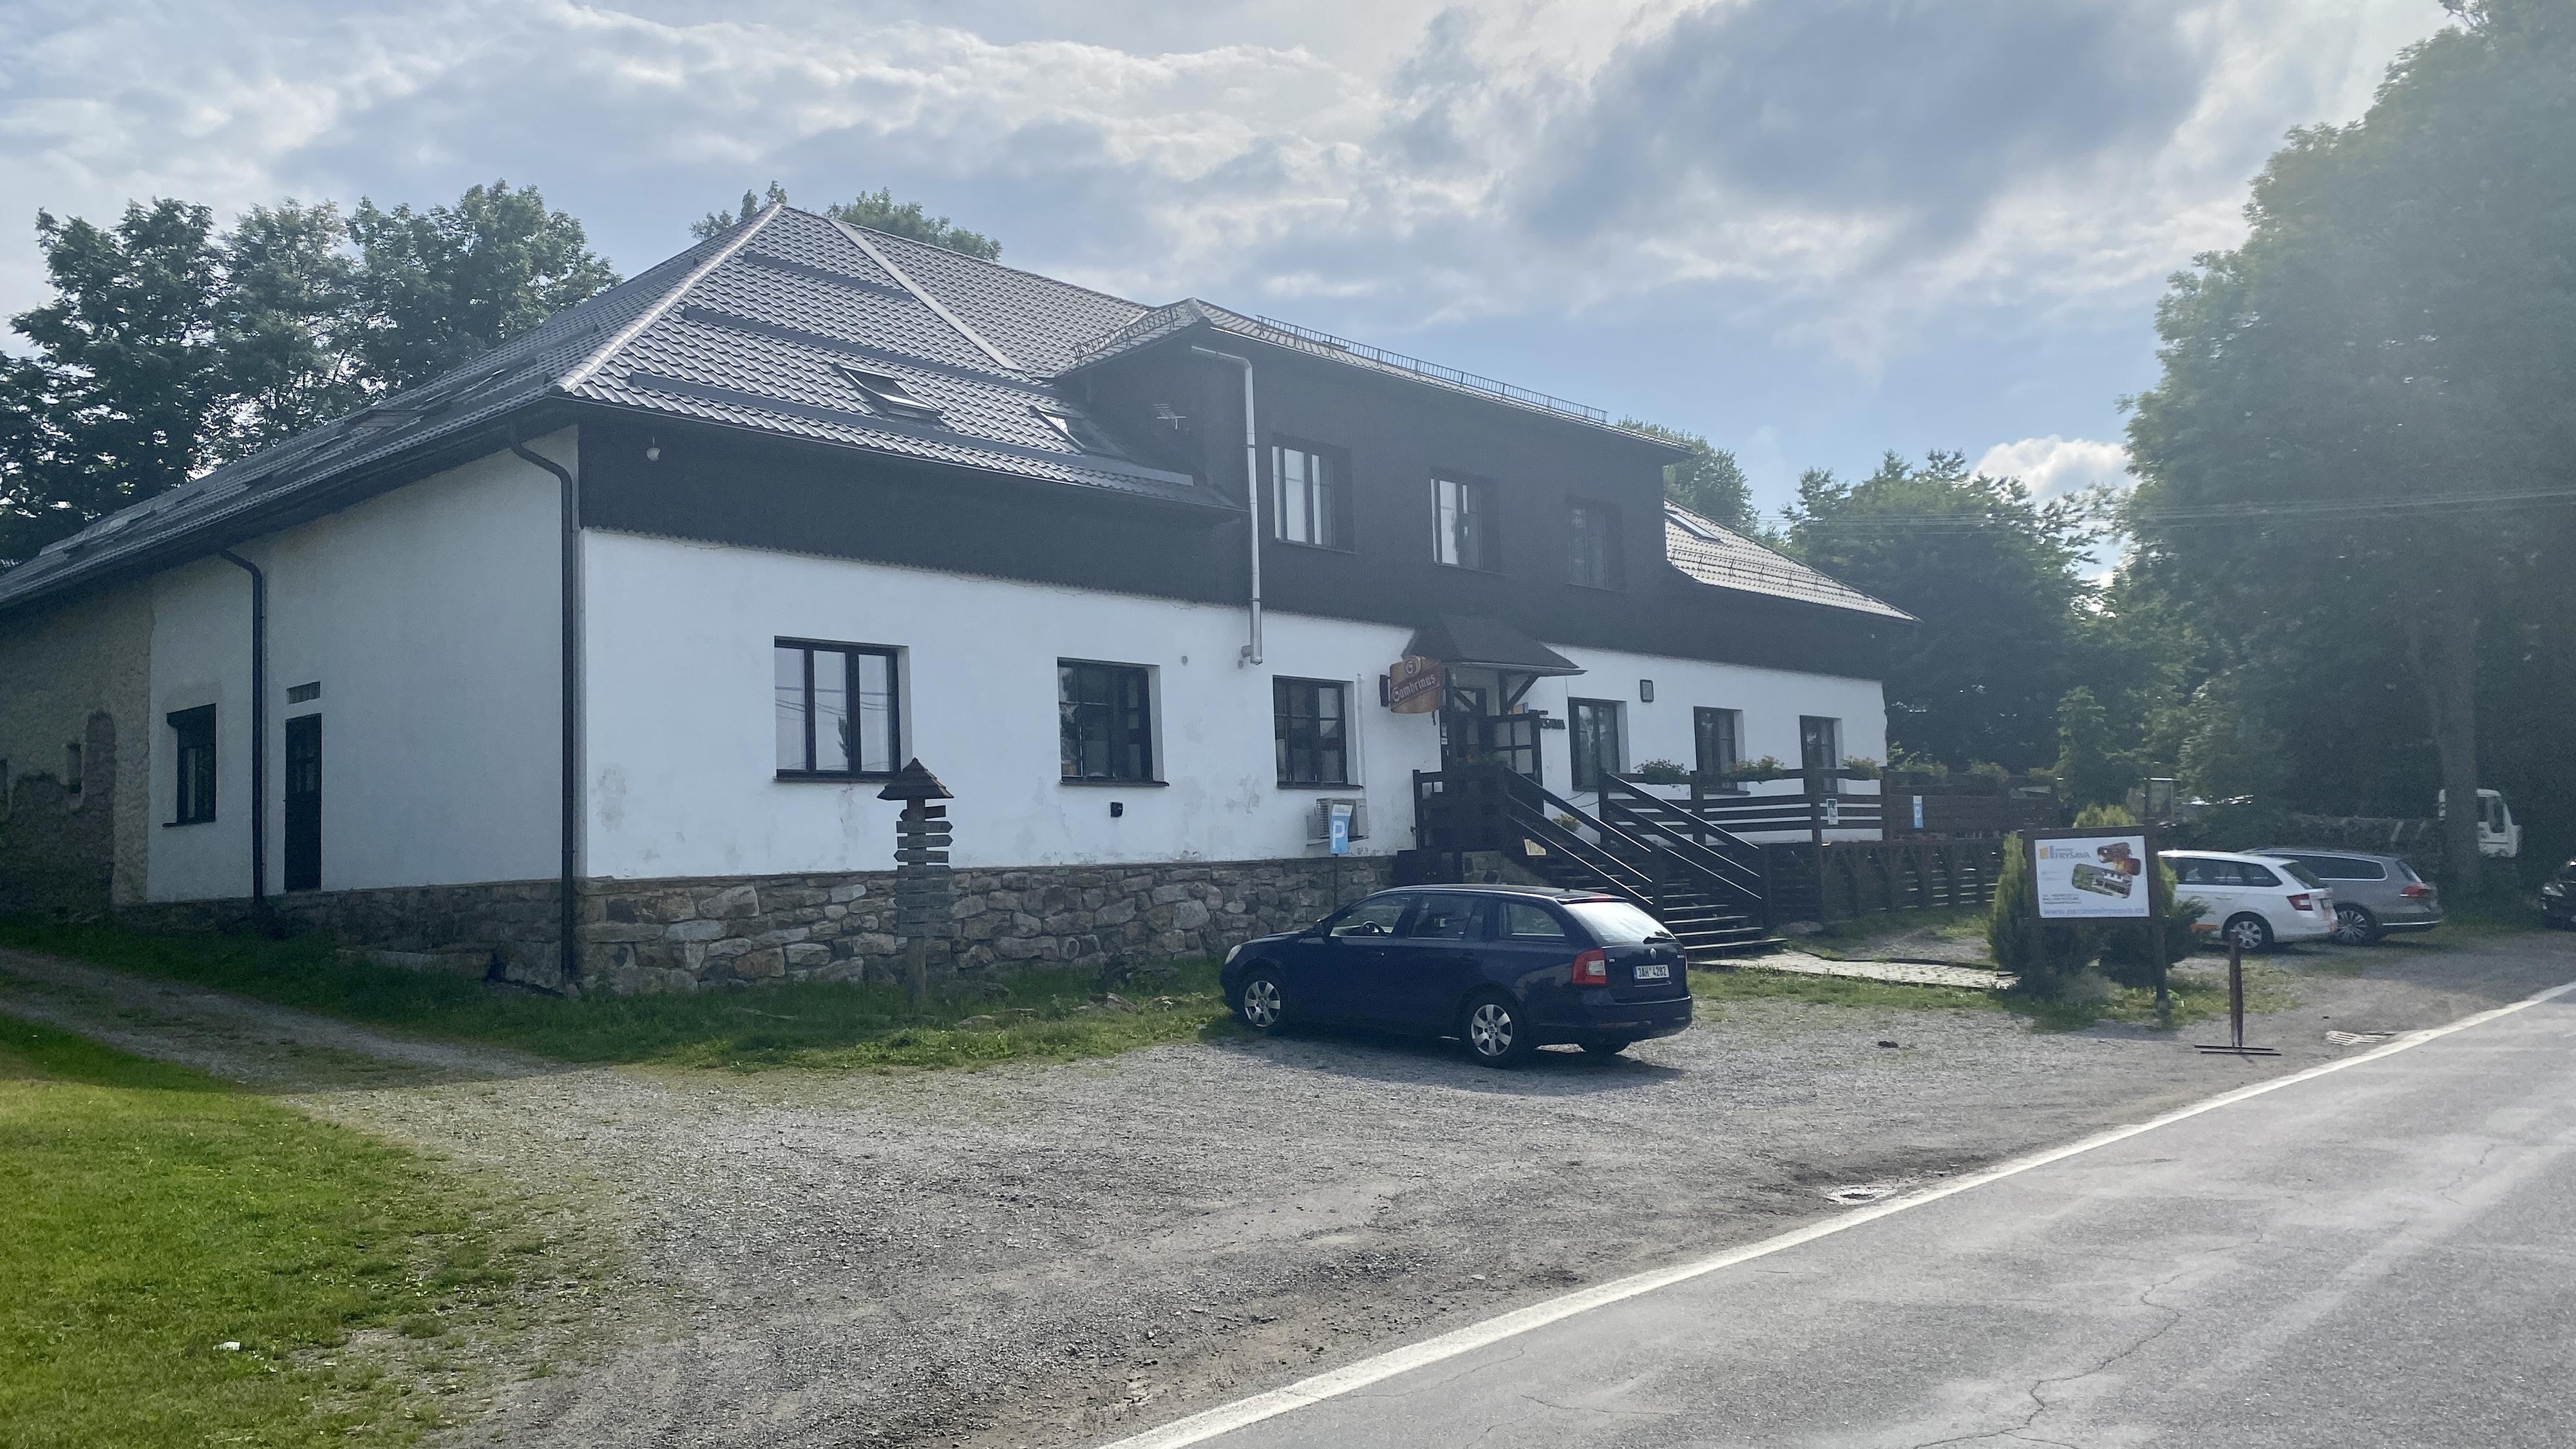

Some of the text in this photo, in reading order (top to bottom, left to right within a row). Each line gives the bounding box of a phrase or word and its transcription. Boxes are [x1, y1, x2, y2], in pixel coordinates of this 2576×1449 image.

[1392, 674, 1435, 701] Gambrinus
[1332, 820, 1345, 849] P
[1638, 967, 1667, 977] 3AH 4282
